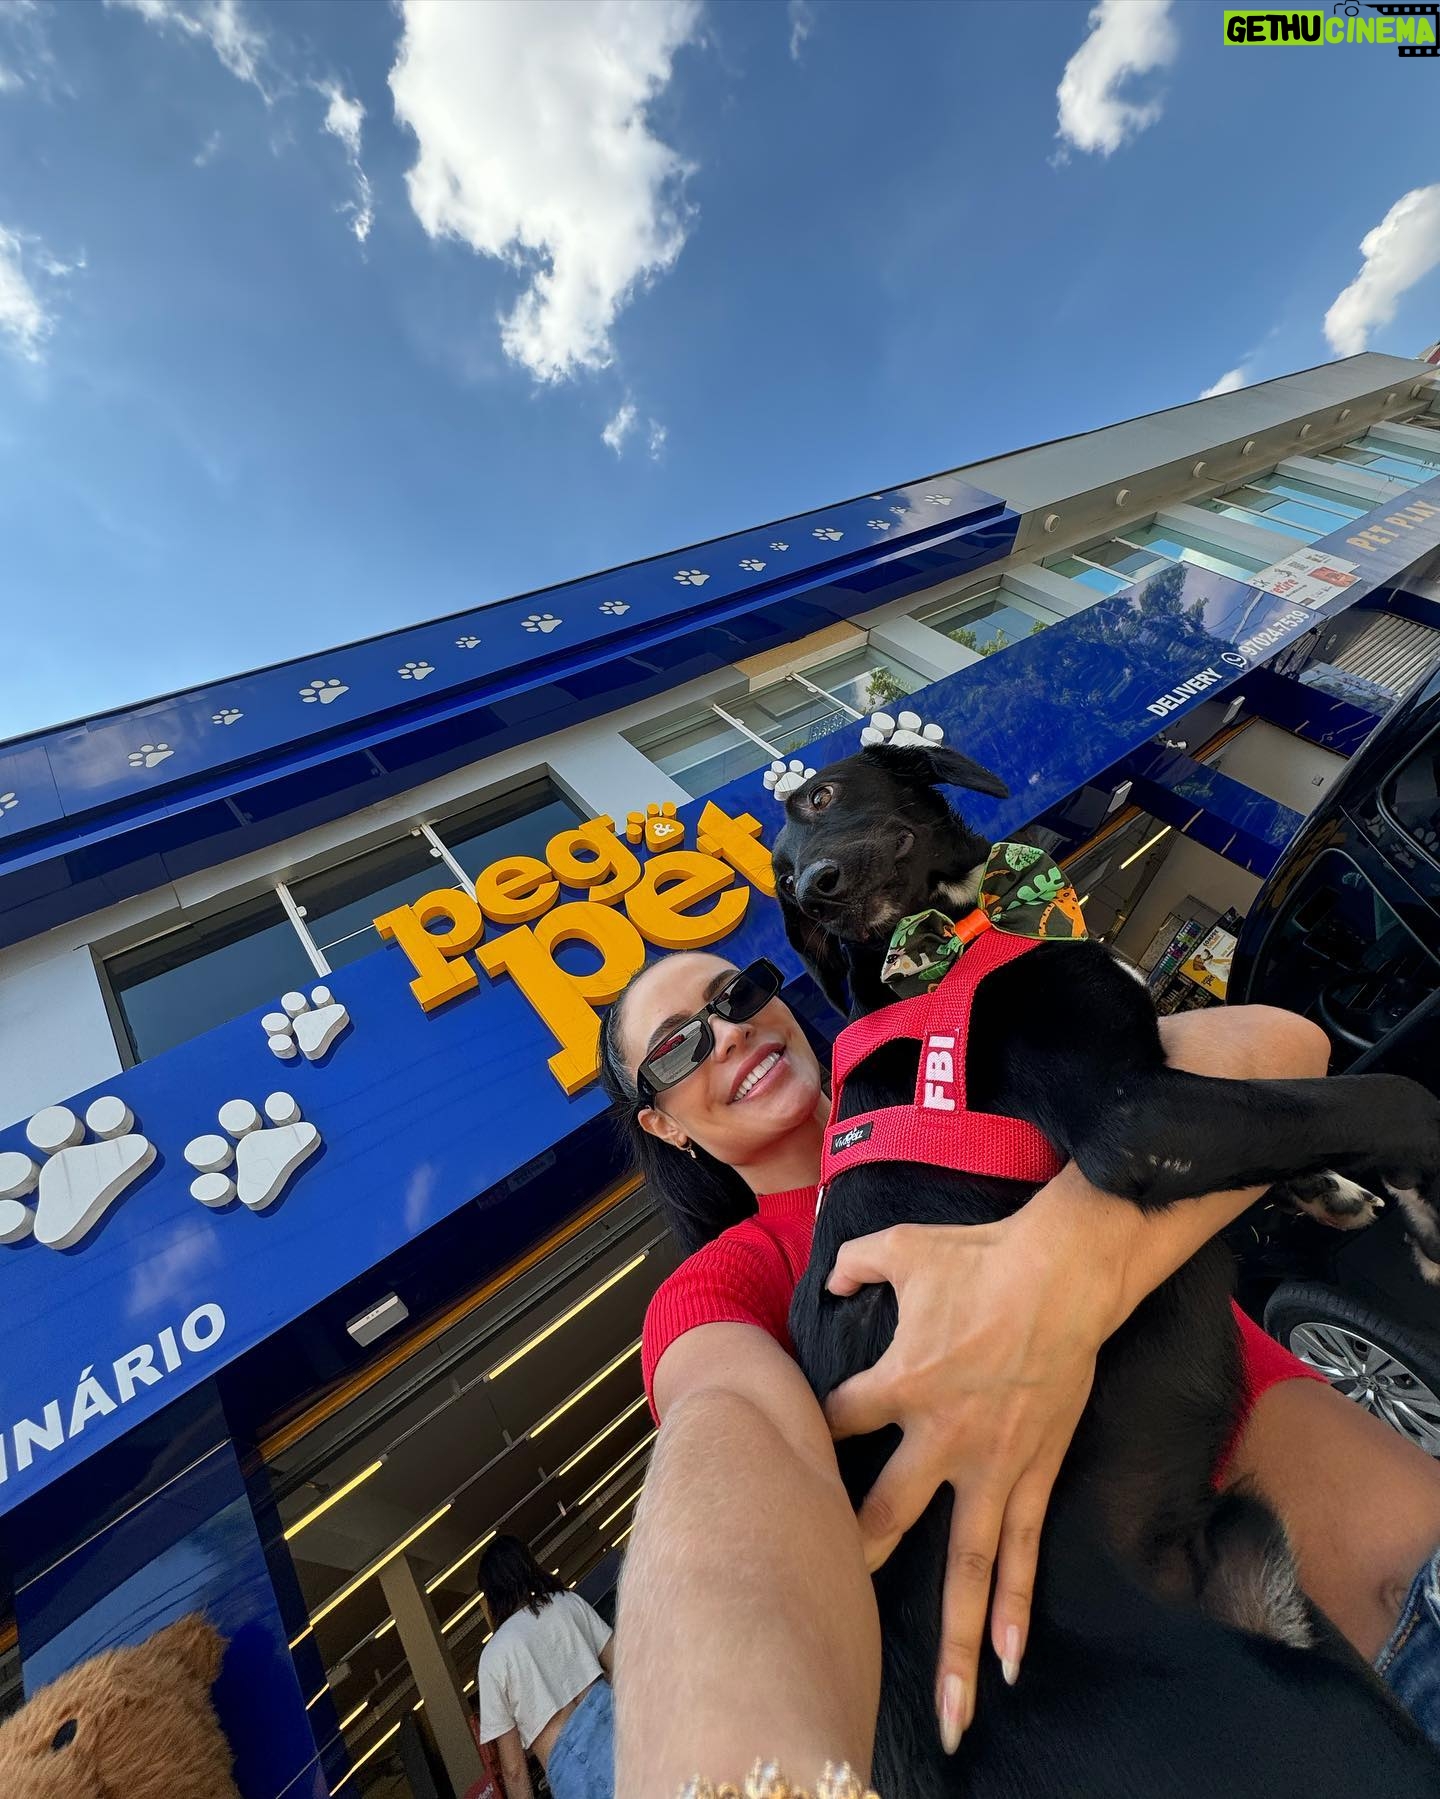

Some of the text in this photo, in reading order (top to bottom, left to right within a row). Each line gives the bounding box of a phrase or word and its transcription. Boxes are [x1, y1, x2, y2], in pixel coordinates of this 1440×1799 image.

[1346, 500, 1440, 552] PET PLAY
[1146, 610, 1310, 717] DELIVERY 97024-7539
[373, 814, 674, 1012] peg &
[475, 801, 776, 1096] pet
[923, 1036, 955, 1111] FBI
